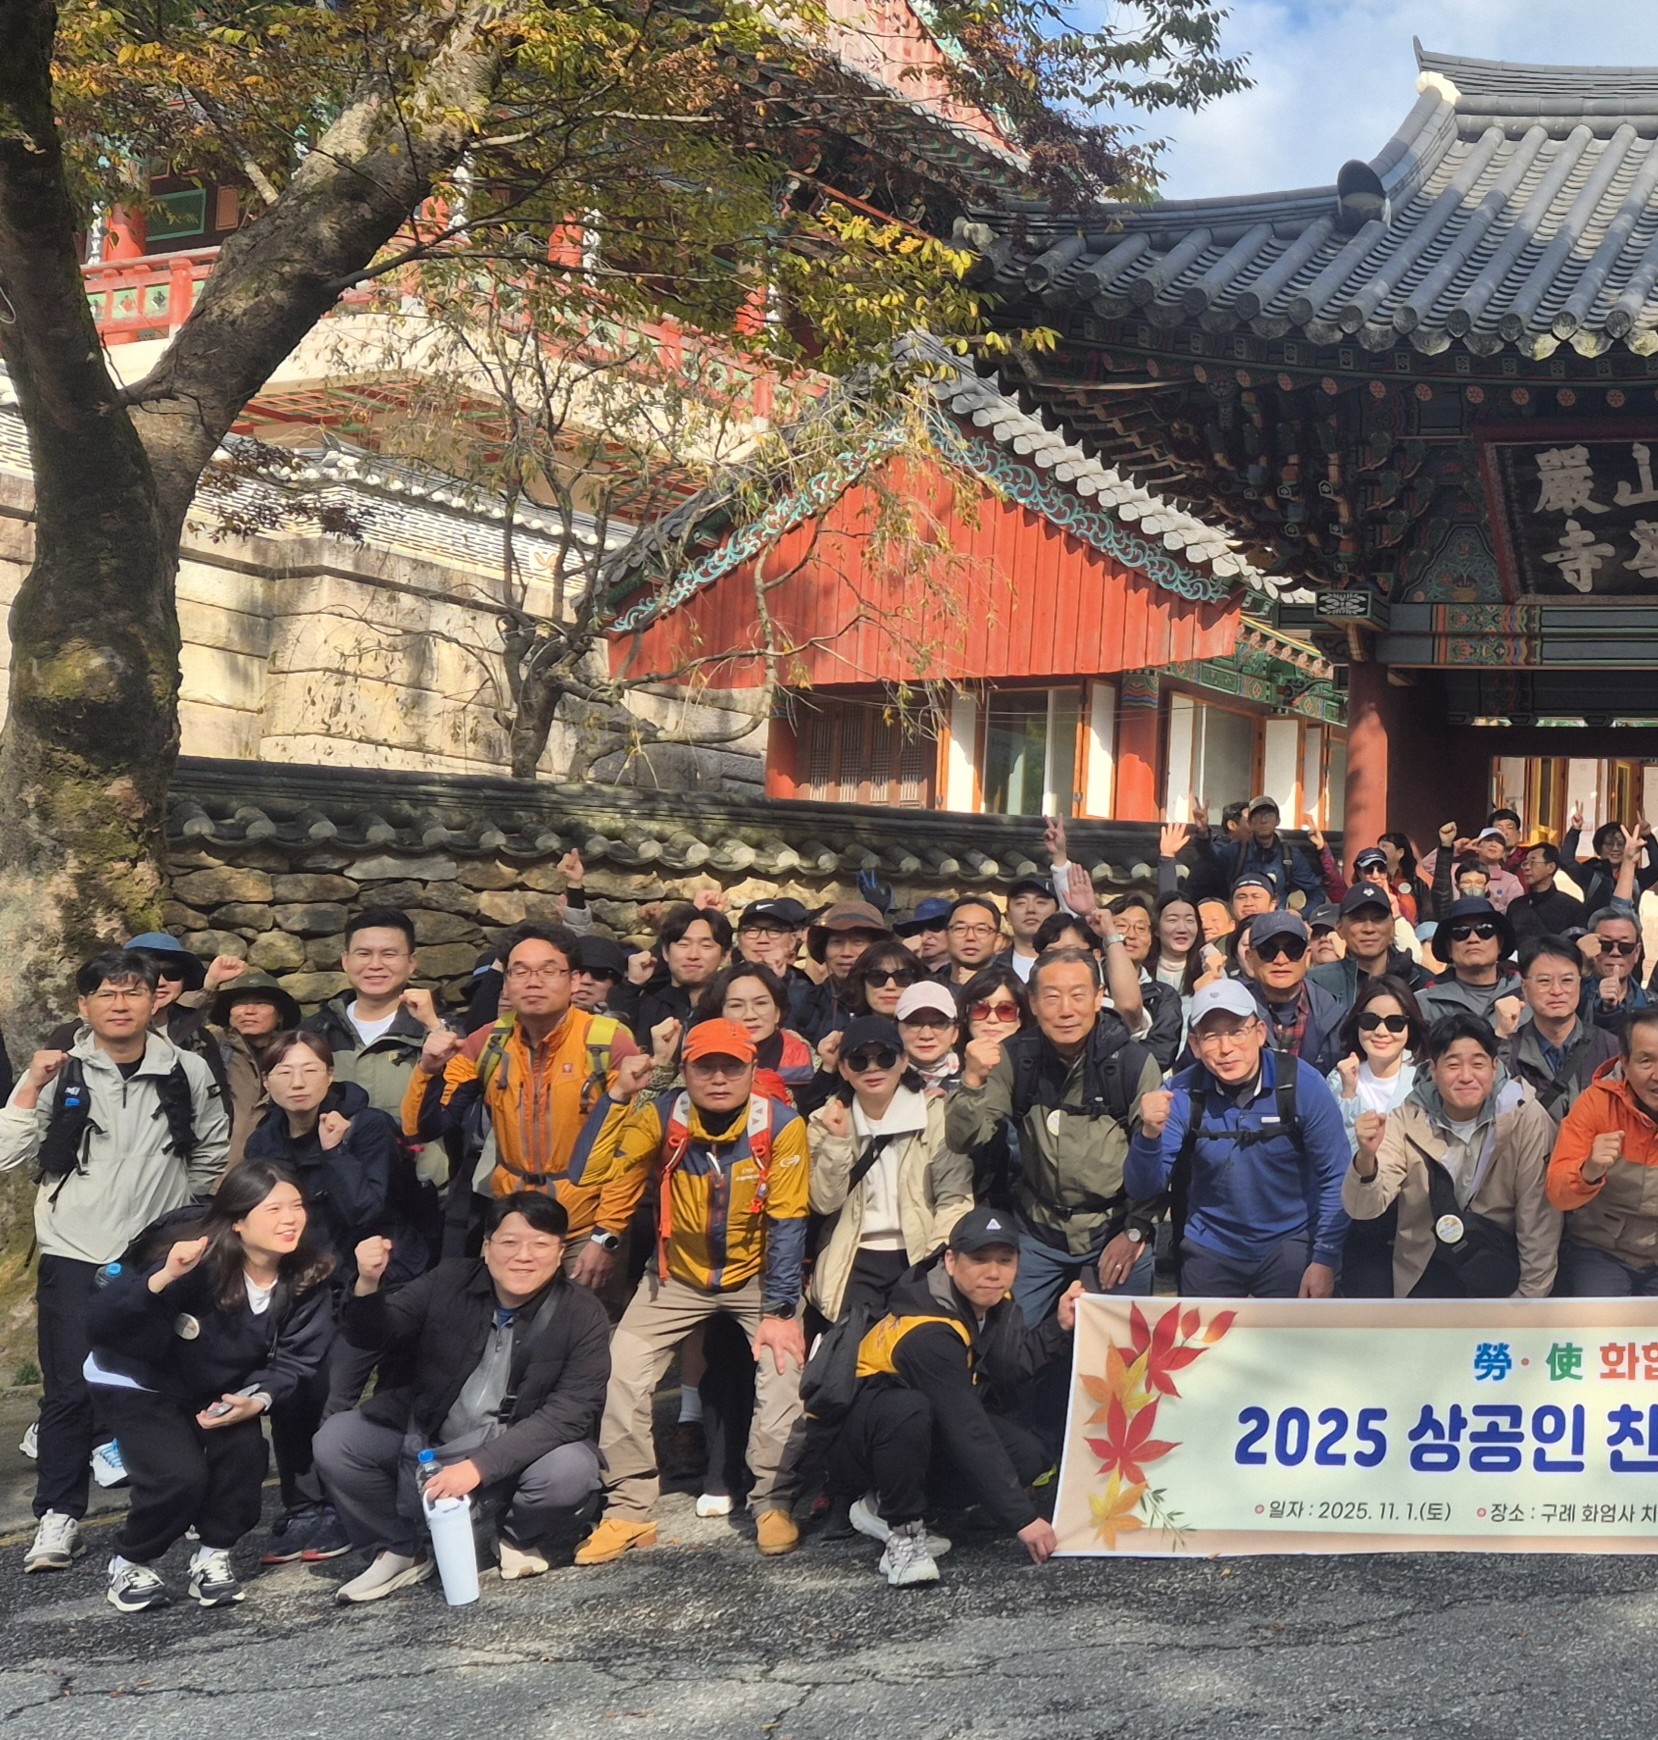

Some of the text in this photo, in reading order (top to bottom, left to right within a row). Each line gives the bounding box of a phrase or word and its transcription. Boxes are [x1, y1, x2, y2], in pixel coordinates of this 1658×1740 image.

[1235, 1406, 1388, 1467] 2025
[1408, 1404, 1585, 1473] 상공인
[1318, 1501, 1372, 1520] 2025.
[1540, 1504, 1575, 1523] 구례
[1581, 1503, 1635, 1524] 화엄사
